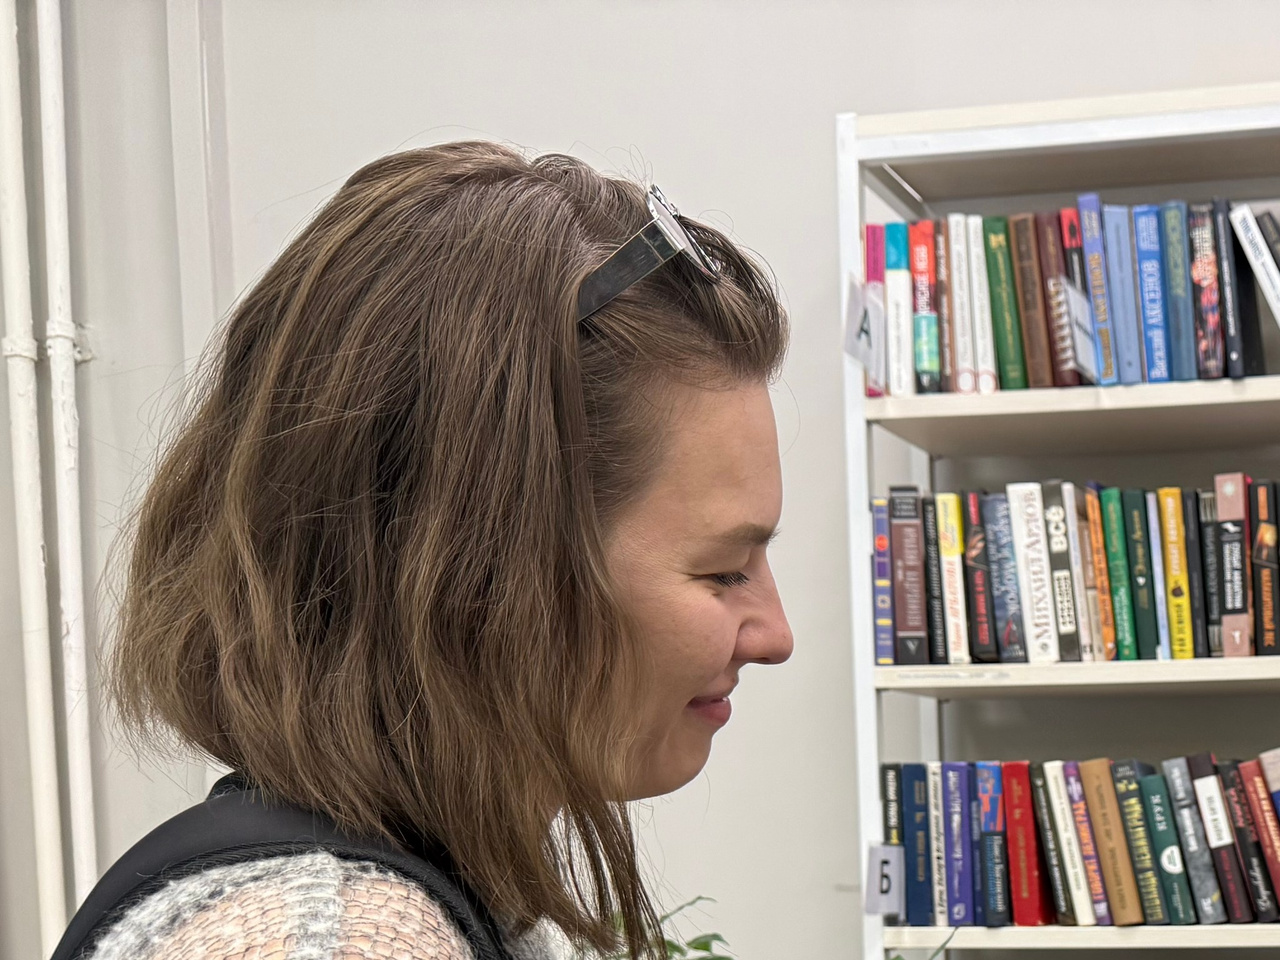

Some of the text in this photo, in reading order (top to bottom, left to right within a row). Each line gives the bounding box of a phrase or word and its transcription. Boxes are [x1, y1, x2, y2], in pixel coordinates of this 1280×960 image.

[1141, 259, 1164, 326] АКСЕНОВ
[857, 305, 873, 350] А
[1150, 794, 1168, 831] КРУК
[1071, 800, 1106, 900] ГОВОРИТ ЛЕНИНГРАД
[1122, 797, 1163, 921] БЛОКАДА ЛЕНИНГРАДА
